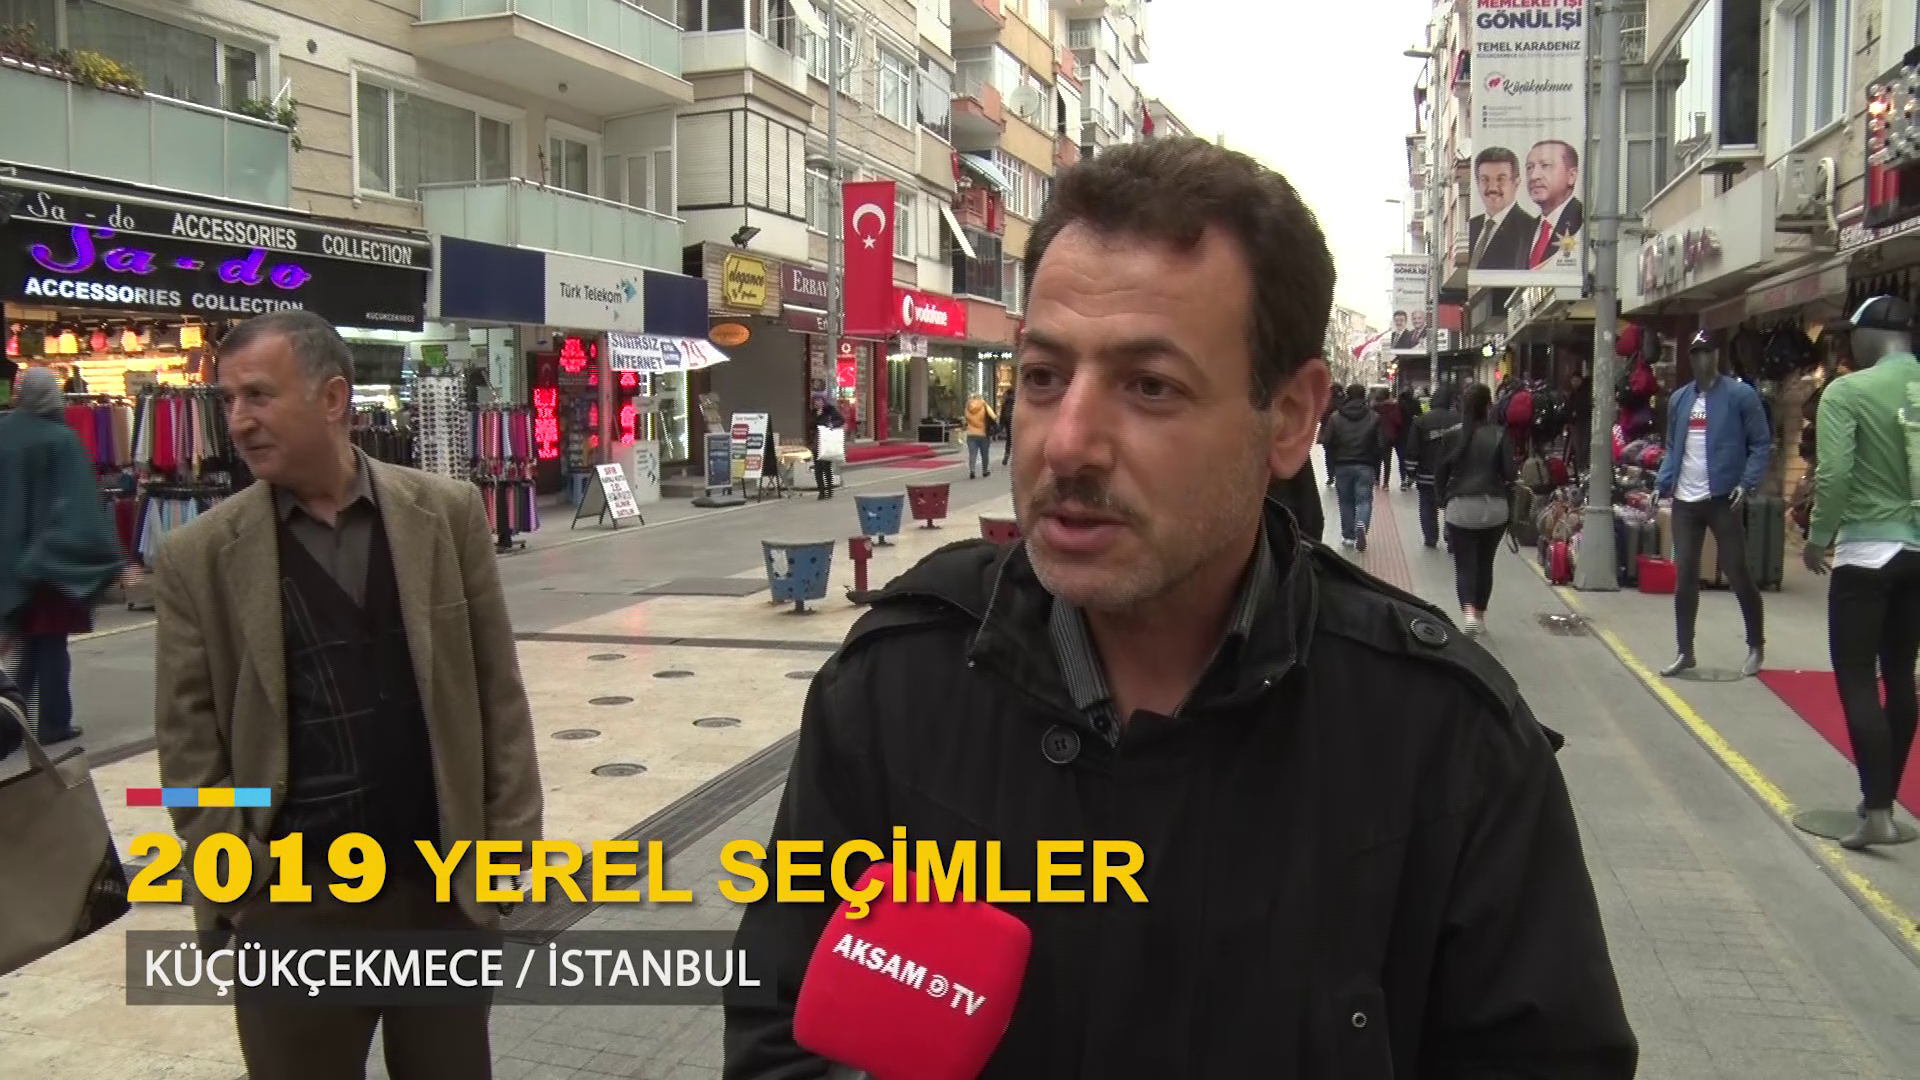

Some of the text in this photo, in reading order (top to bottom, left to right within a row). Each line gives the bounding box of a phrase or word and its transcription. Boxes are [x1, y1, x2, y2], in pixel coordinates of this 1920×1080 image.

[1476, 8, 1583, 31] GÖNÜL İŞİ
[1476, 40, 1581, 52] TEMEL KARADENİZ
[1502, 79, 1574, 97] Küçükçekmece
[27, 192, 66, 222] Sa
[108, 203, 135, 230] do
[171, 212, 297, 251] ACCESSORIES
[321, 234, 413, 266] COLLECTION
[29, 223, 157, 275] Sa
[217, 248, 312, 290] do
[24, 276, 303, 314] ACCESSORIES COLLECTION
[559, 281, 623, 304] Türk Telekom
[832, 933, 987, 1016] AKSAM TV
